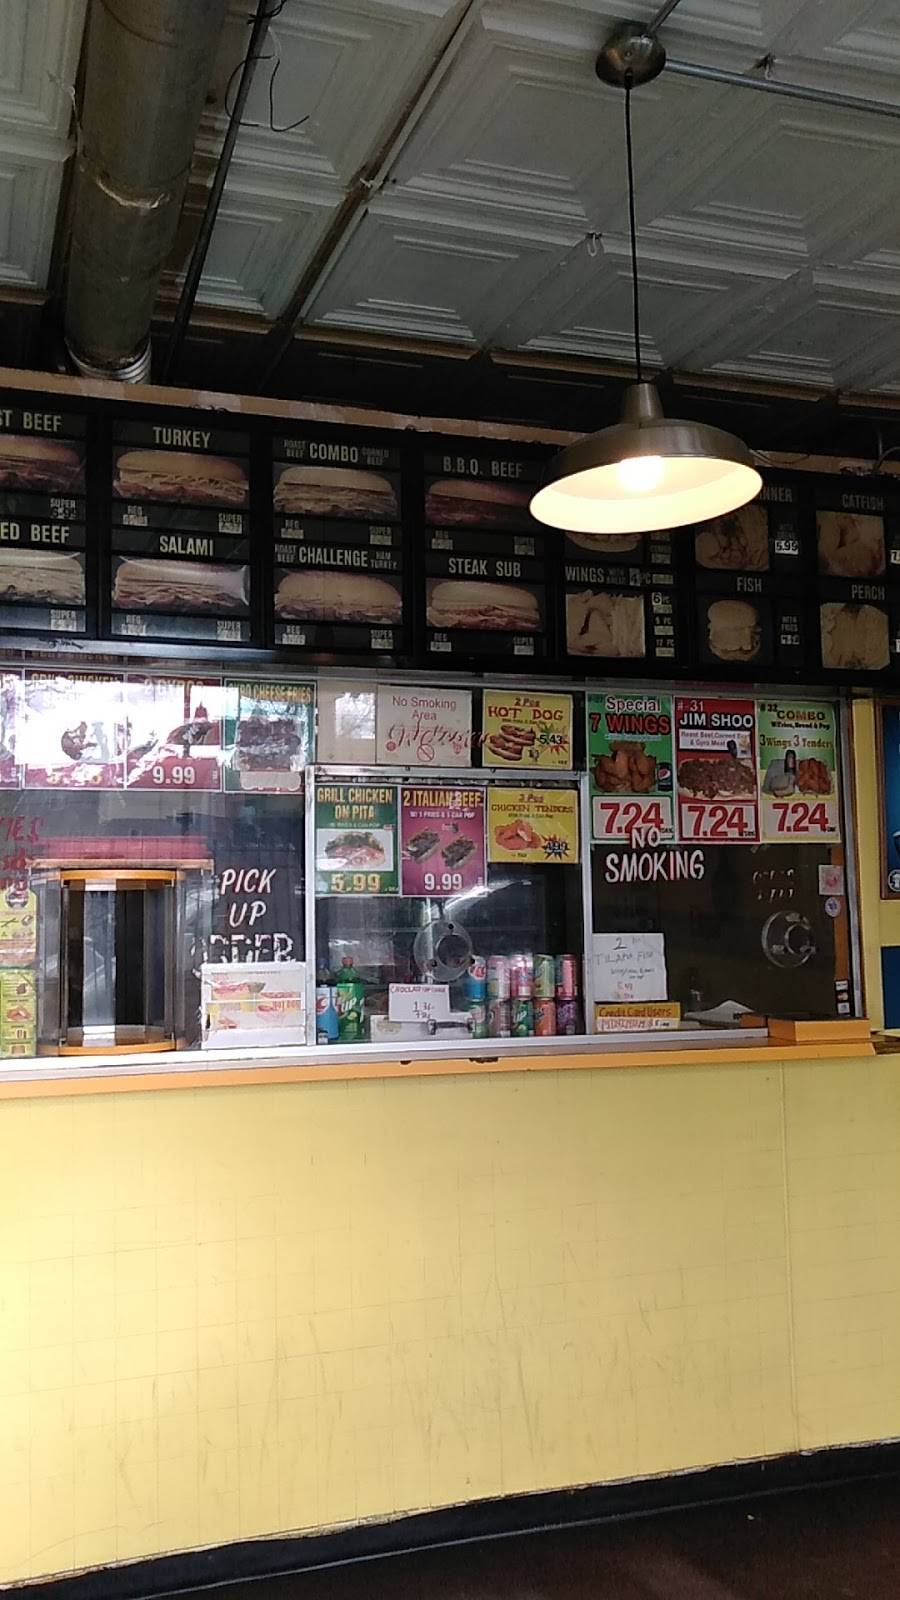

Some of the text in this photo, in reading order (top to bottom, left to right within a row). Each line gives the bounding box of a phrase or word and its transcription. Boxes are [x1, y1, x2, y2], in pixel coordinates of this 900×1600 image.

[23, 412, 62, 431] BEEF
[153, 426, 210, 448] TURKEY
[309, 442, 358, 463] COMBO
[443, 456, 522, 478] B.B.Q. BEEF
[841, 494, 884, 510] CATFISH
[31, 524, 70, 544] BEEF
[159, 536, 214, 556] SALAMI
[776, 541, 798, 553] 5.99
[299, 547, 368, 568] CHALLENGE
[449, 558, 521, 577] STEAK SUB
[565, 565, 605, 583] WINGS
[737, 577, 762, 592] FISH
[851, 584, 885, 600] PERCH
[253, 685, 286, 701] CHEESE
[392, 695, 457, 711] No Smoking
[606, 695, 661, 713] Special
[689, 700, 704, 713] 31
[412, 710, 437, 721] Area
[488, 706, 563, 720] HOT DOG
[680, 713, 753, 728] JIM SHOO
[777, 710, 826, 720] COMBO
[590, 713, 671, 735] 7 WINGS
[539, 735, 563, 744] 5.43
[766, 737, 792, 749] Wings
[793, 734, 800, 747] 3
[152, 766, 195, 785] 9.99
[317, 787, 393, 804] GRILL CHICKEN
[403, 790, 482, 808] 2 ITALIAN BEEF
[334, 805, 375, 820] ON PITA
[491, 804, 530, 813] CHICKEN
[772, 803, 829, 832] 7.24
[600, 803, 664, 834] 7.24
[687, 806, 748, 837] 7.24
[631, 828, 661, 849] NO
[605, 850, 705, 883] SMOKING
[220, 869, 277, 895] PICK
[330, 873, 381, 892] 5.99
[424, 873, 463, 891] 9.99
[229, 900, 266, 927] UP
[613, 937, 628, 950] 2
[627, 1006, 648, 1017] Card
